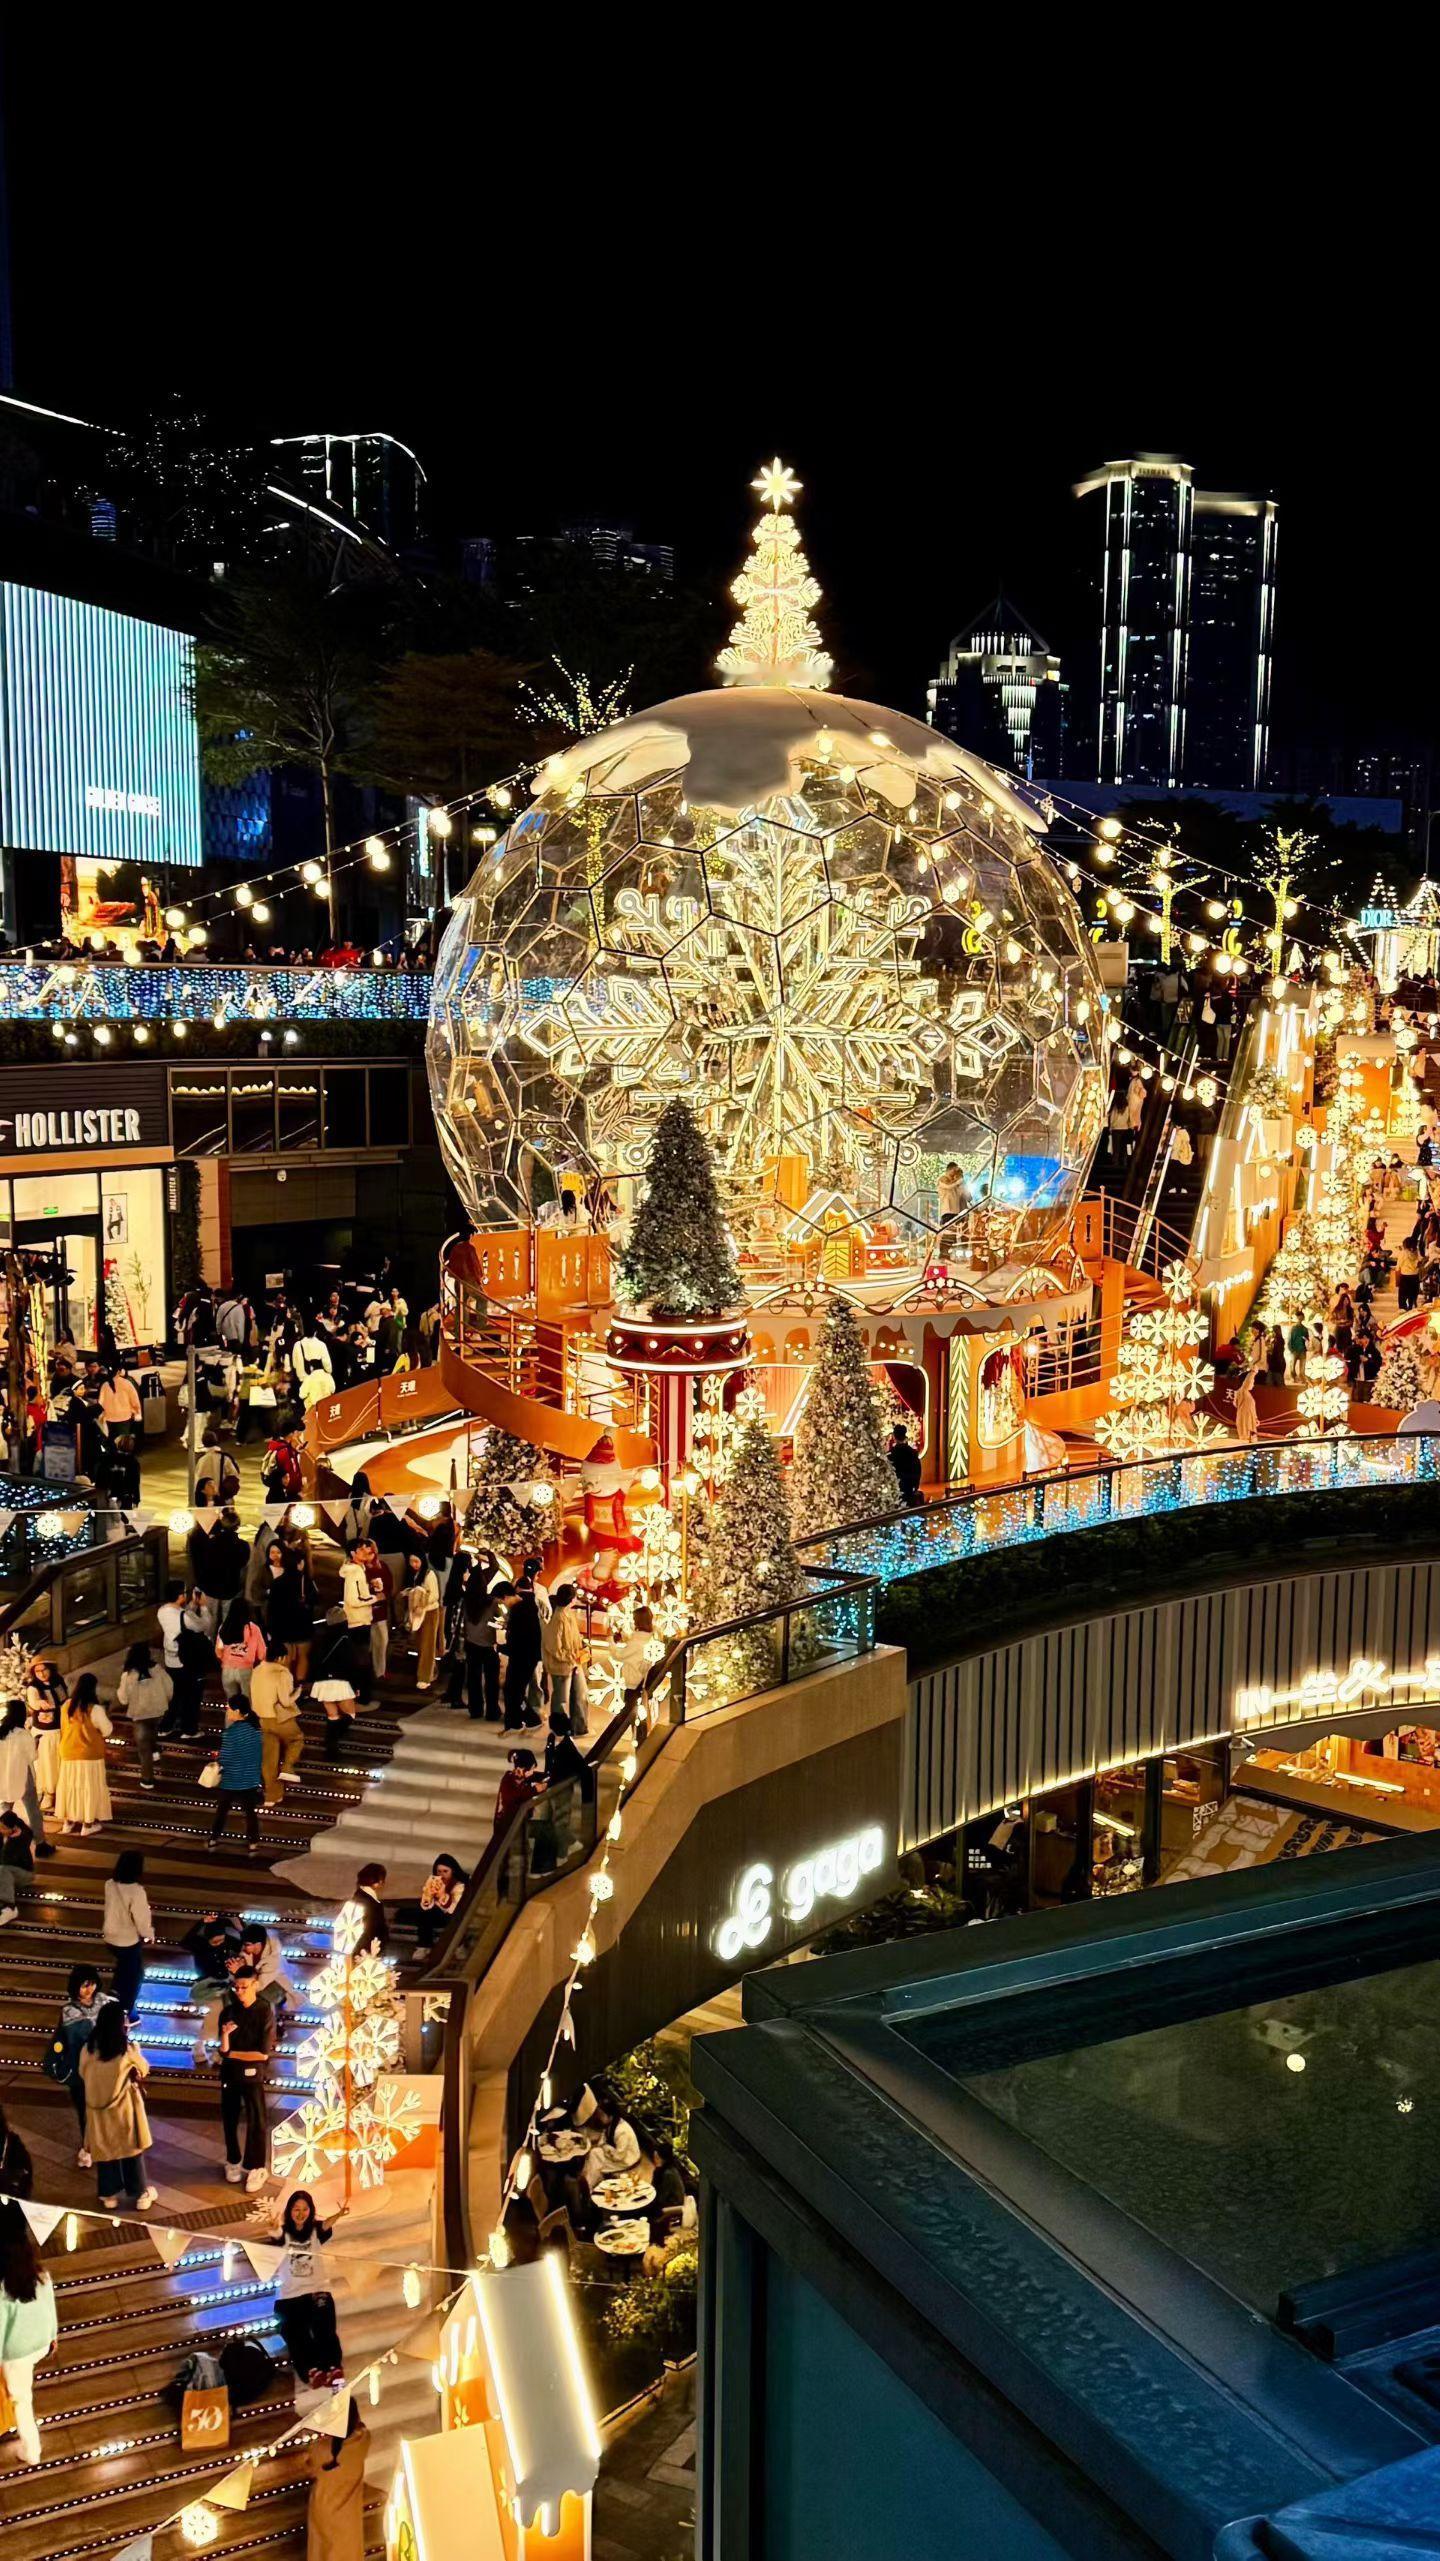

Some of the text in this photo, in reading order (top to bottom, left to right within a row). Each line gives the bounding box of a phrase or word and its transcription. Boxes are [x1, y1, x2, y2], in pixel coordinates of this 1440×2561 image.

[1361, 909, 1392, 928] DIOR
[15, 1108, 141, 1147] HOLLISTER
[787, 1826, 883, 1922] gaga
